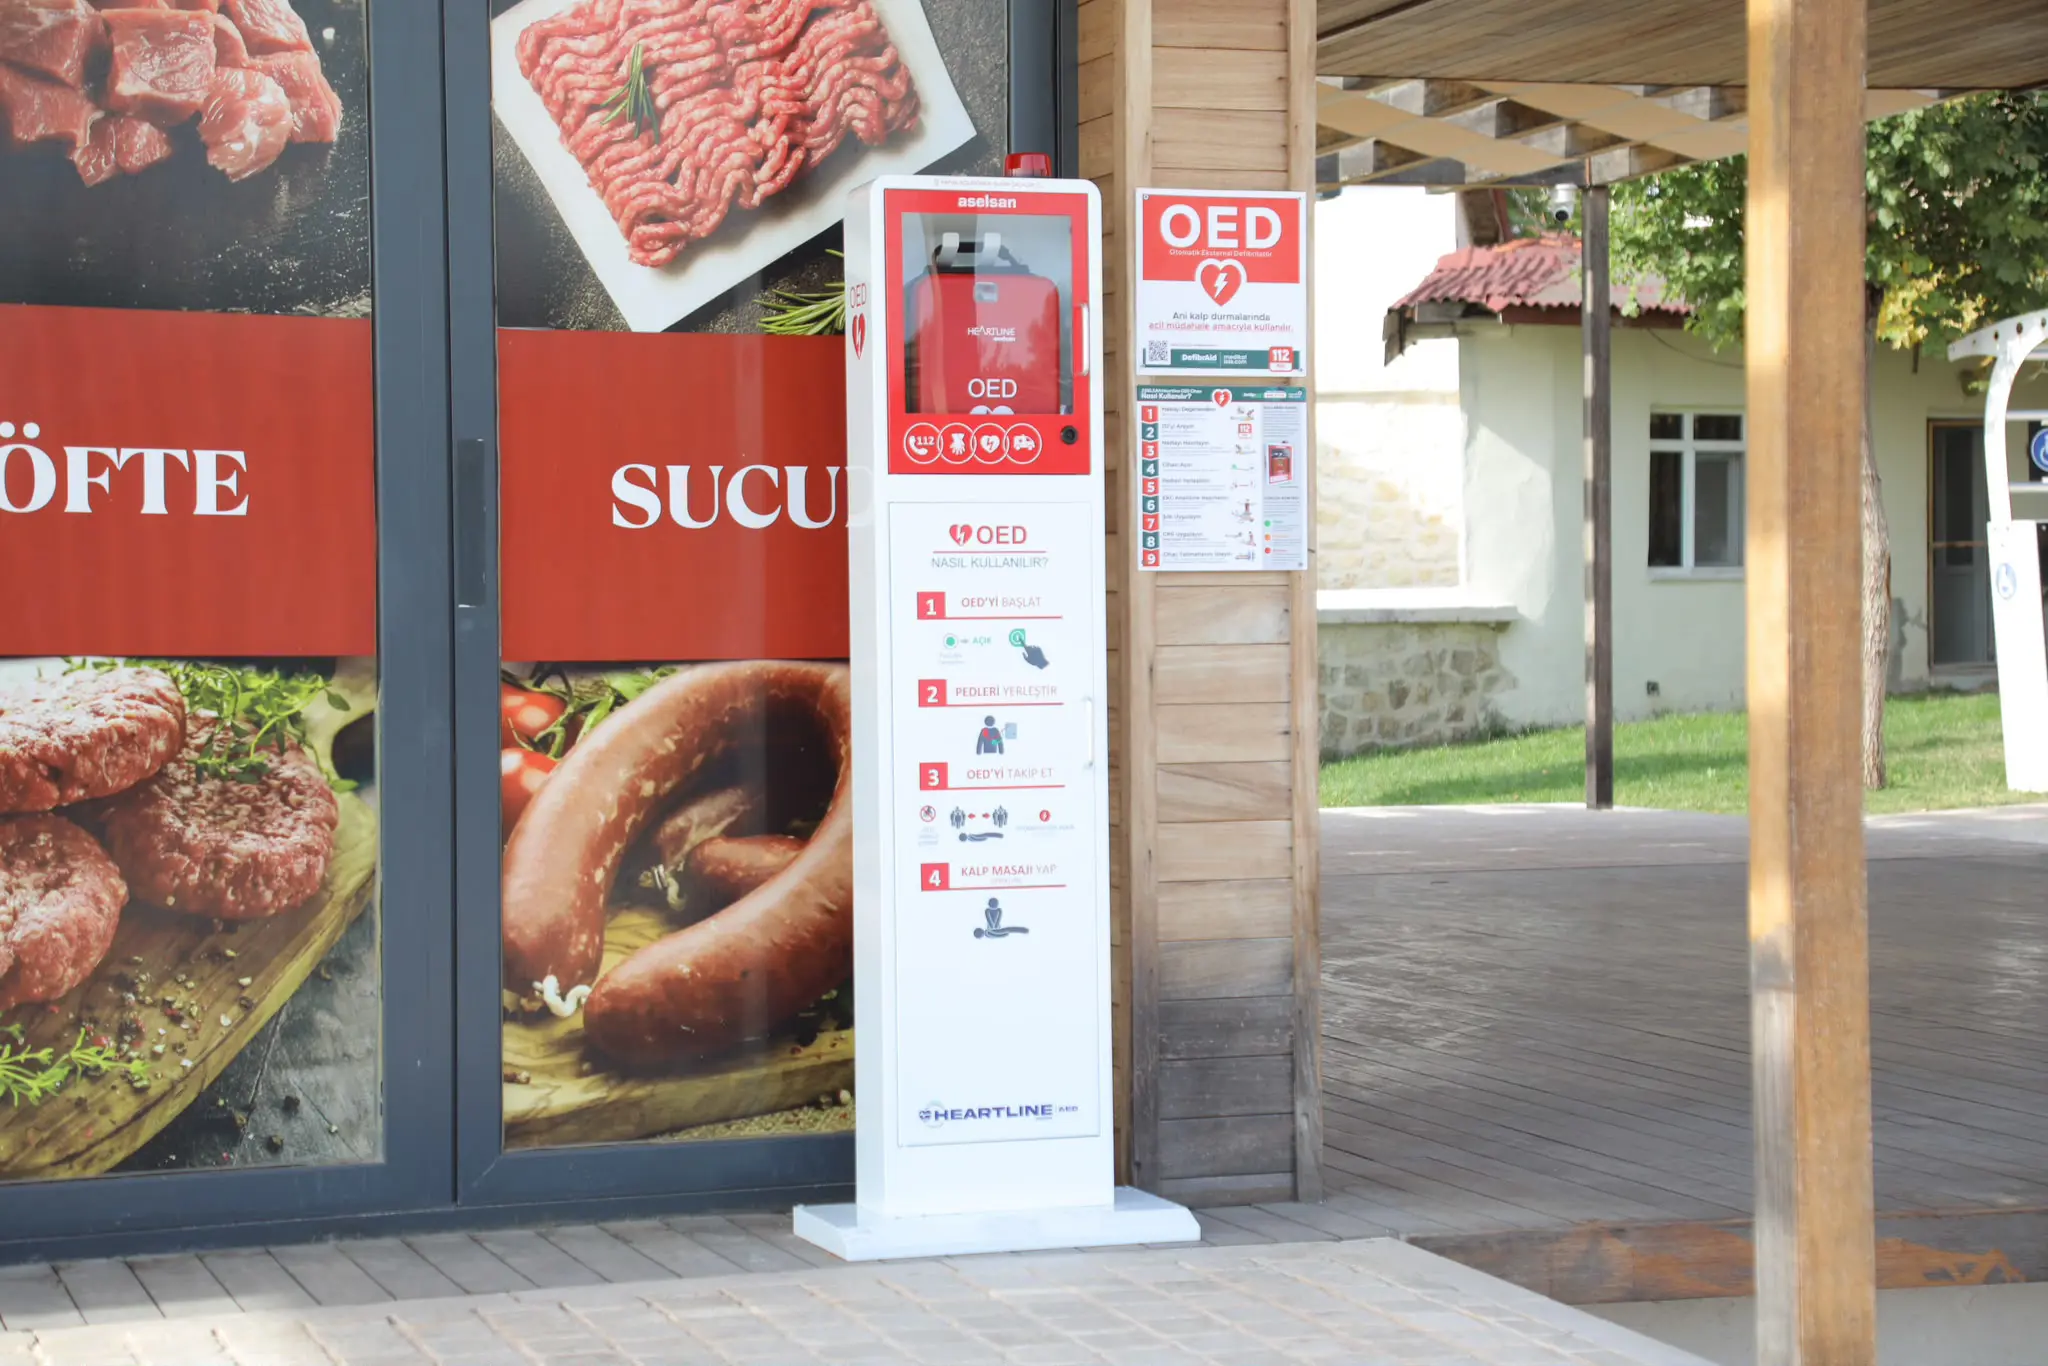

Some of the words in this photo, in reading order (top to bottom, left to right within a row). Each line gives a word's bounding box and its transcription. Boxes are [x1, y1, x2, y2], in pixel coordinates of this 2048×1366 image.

[958, 194, 1017, 208] aselsan
[1160, 204, 1282, 249] OED
[850, 283, 867, 308] OED
[1172, 312, 1188, 320] Ani
[1189, 312, 1209, 322] kalp
[1272, 349, 1290, 361] 112
[968, 377, 1018, 398] OED
[1147, 408, 1153, 420] 1
[1146, 427, 1155, 438] 2
[917, 436, 935, 446] 112
[1146, 445, 1155, 456] 3
[0, 421, 249, 516] ÖFTE
[1146, 463, 1155, 475] 4
[1147, 481, 1155, 493] 5
[611, 463, 849, 529] SUCU
[1147, 500, 1155, 512] 6
[1147, 518, 1155, 530] 7
[976, 525, 1028, 545] OED
[1147, 536, 1155, 548] 8
[931, 557, 967, 568] NASIL
[971, 557, 1049, 569] KULLANILIR?
[1147, 554, 1156, 566] 9
[926, 599, 937, 616] 1
[961, 596, 999, 608] OED'Yİ
[1001, 596, 1041, 610] BAŞLAT
[972, 636, 992, 647] AÇIK
[927, 686, 939, 703] 2
[955, 685, 1000, 697] PEDLERİ
[1003, 684, 1058, 699] YERLEŞTİR
[928, 769, 940, 787] 3
[967, 767, 1004, 780] OED'Yİ
[1007, 767, 1038, 779] TAKİP
[1041, 767, 1054, 778] ET
[929, 870, 942, 887] 4
[961, 865, 989, 877] KALP
[992, 864, 1033, 876] MASAJI
[1036, 864, 1058, 875] YAP
[934, 1104, 1053, 1121] HEARTLINE
